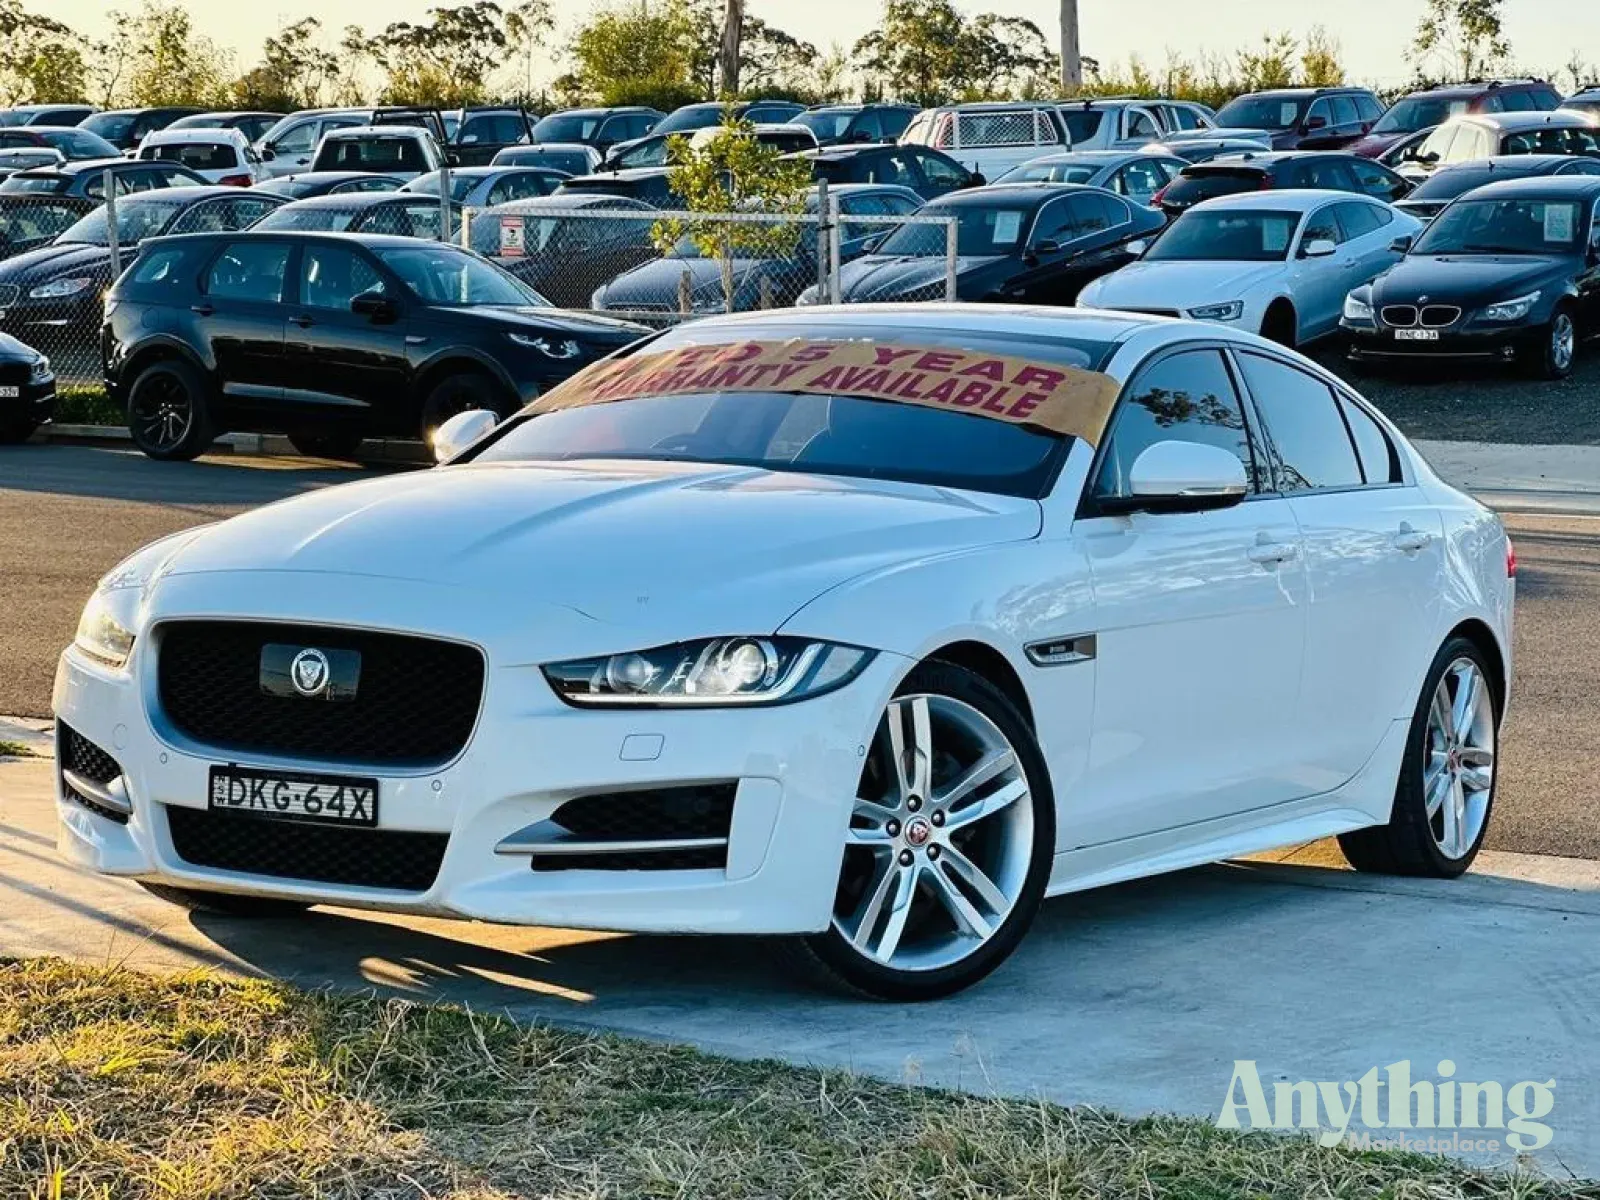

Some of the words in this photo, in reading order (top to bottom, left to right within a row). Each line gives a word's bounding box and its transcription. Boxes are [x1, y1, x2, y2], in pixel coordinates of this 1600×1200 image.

[789, 345, 835, 362] 5
[874, 347, 1066, 391] YEAR
[805, 364, 1048, 418] AVAILABLE
